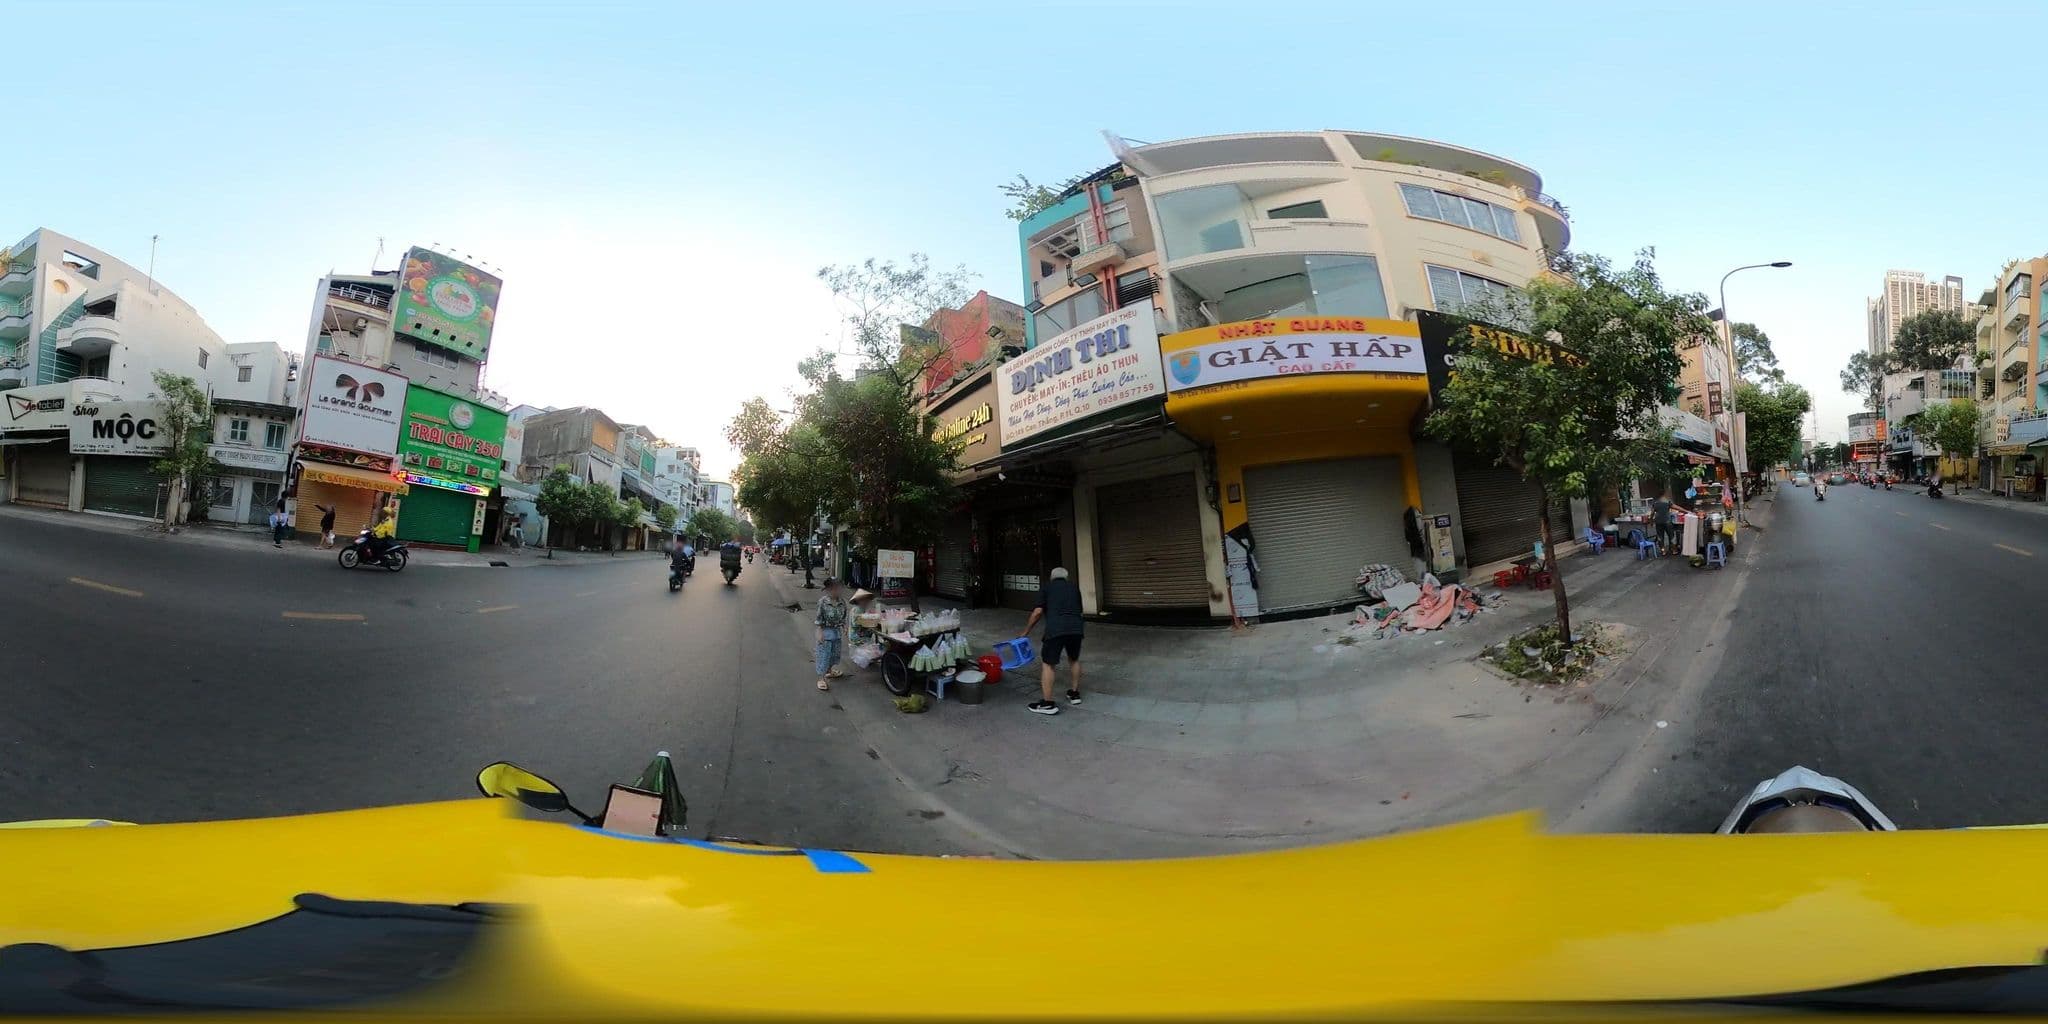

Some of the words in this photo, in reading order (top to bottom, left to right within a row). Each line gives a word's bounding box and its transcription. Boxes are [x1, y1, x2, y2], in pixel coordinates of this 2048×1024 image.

[1218, 322, 1276, 339] NHẬT
[1290, 319, 1366, 332] QUANG
[1011, 347, 1073, 395] ĐỊNH
[1075, 323, 1130, 364] THI
[1096, 362, 1109, 377] ÁO
[1112, 353, 1139, 370] THUN
[1208, 340, 1314, 369] GIẶT
[1329, 336, 1412, 359] HẤP
[1278, 363, 1313, 374] CAO
[1322, 360, 1355, 371] CẤP
[73, 405, 99, 417] Shop
[319, 394, 328, 402] Le
[331, 396, 356, 408] Grand
[357, 402, 392, 416] Gourmet
[972, 401, 990, 428] 24h
[93, 413, 156, 443] MỘC
[409, 420, 443, 445] TRÁI
[445, 430, 474, 451] CÂY
[475, 440, 500, 459] 350
